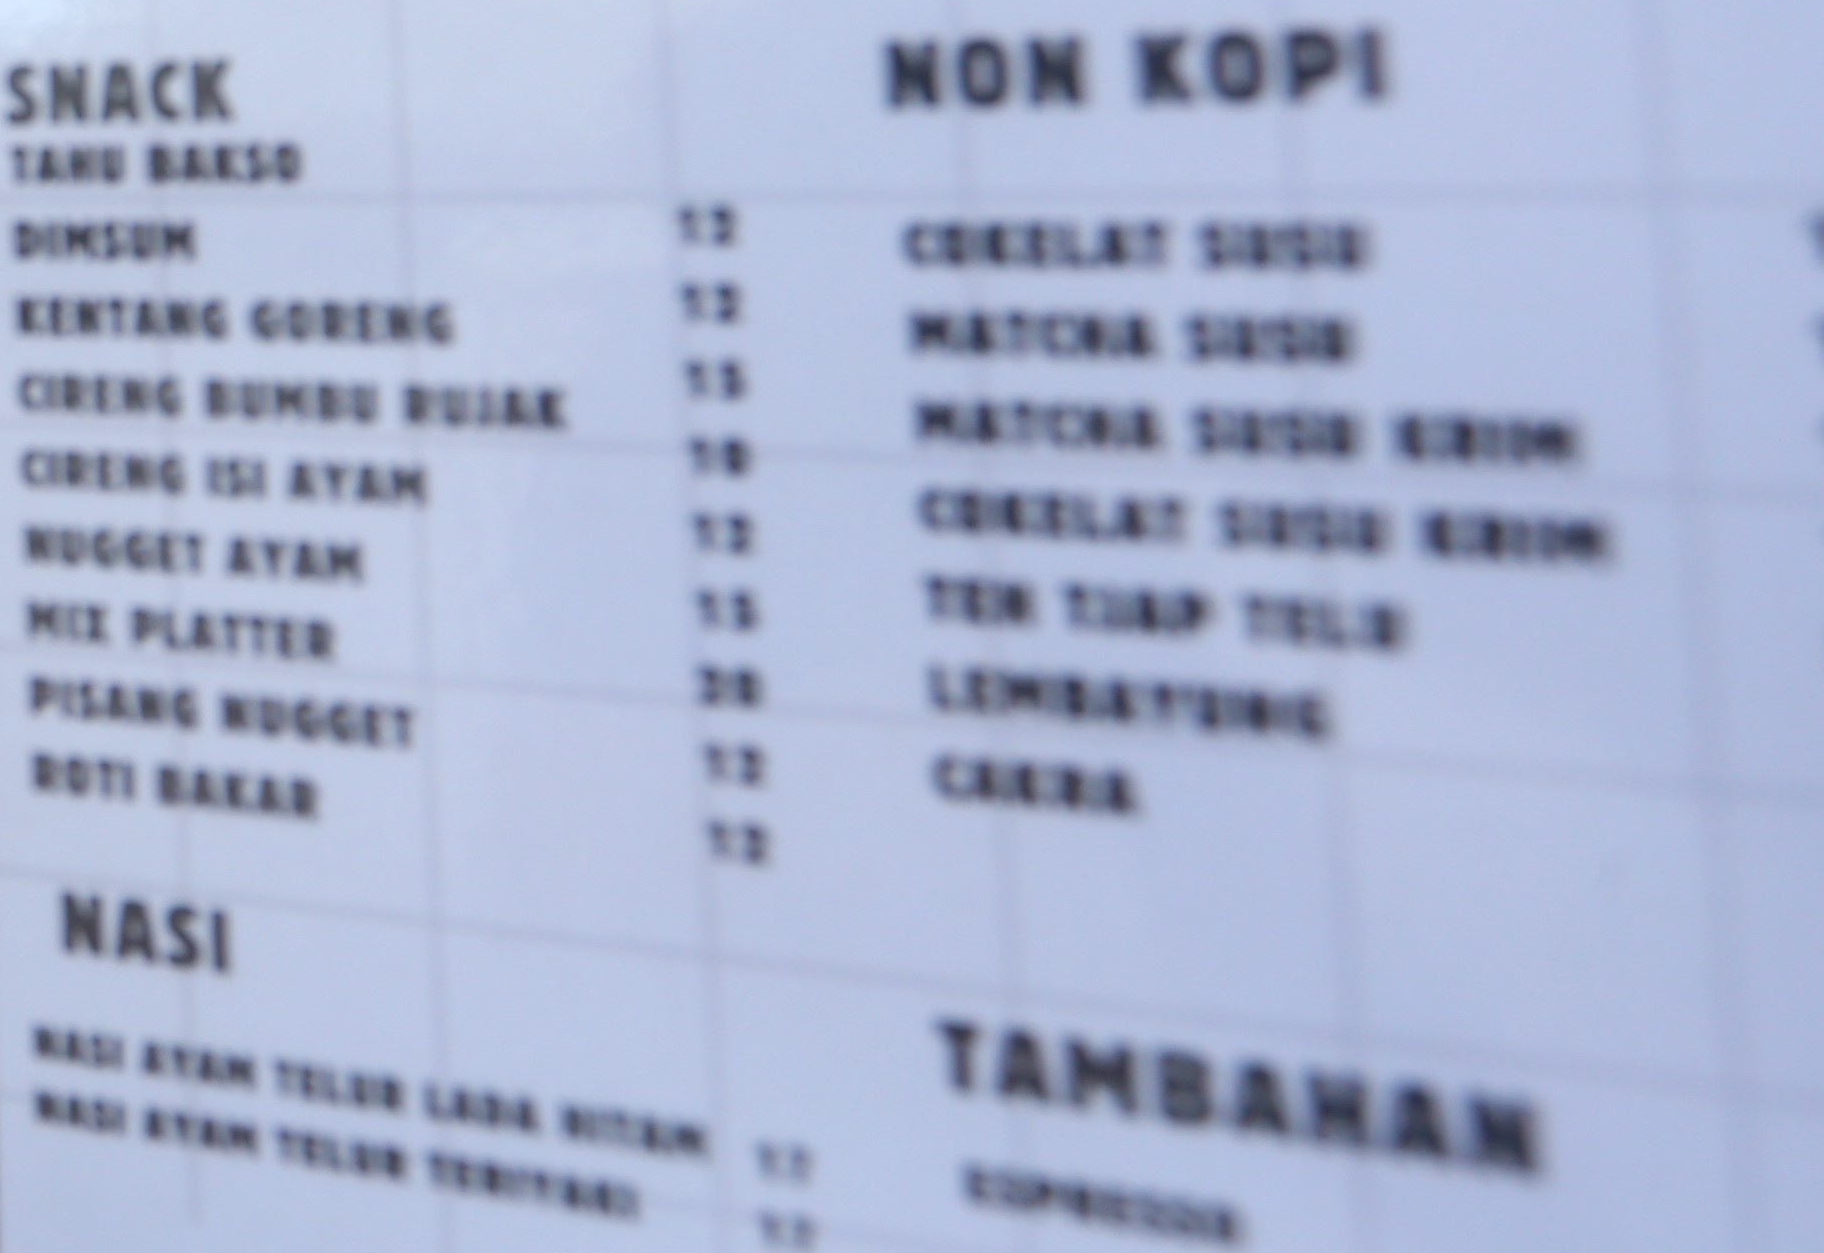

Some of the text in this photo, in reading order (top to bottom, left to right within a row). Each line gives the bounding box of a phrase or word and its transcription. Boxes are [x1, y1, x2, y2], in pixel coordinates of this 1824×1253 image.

[6, 60, 231, 126] SNACK
[887, 29, 1384, 108] NON KOPI
[13, 144, 299, 183] TAHU BAKSO
[14, 222, 194, 260] DIMSUM
[904, 222, 1365, 270] COKELAT SUSU
[16, 297, 451, 344] KENTANG GORENG
[911, 312, 1351, 364] MATCHA SUSU
[18, 374, 564, 430] CIRENG BUMBU RUJAK
[916, 401, 1161, 450] MATCHA
[21, 450, 425, 502] CIRENG ISI AYAM
[919, 489, 1183, 542] COKELAT
[24, 526, 361, 579] NUGGET AYAM
[27, 602, 334, 661] MIX PLATTER
[29, 676, 413, 747] PISANG NUGGET
[31, 752, 317, 819] ROTI BAKAR
[61, 891, 229, 973] NASI
[32, 1026, 708, 1157] NASI AYAM TELUR LADA HITAM
[938, 1020, 1542, 1182] TAMBAHAN
[34, 1091, 646, 1218] NASI AYAM TELUR TERIYAKI
